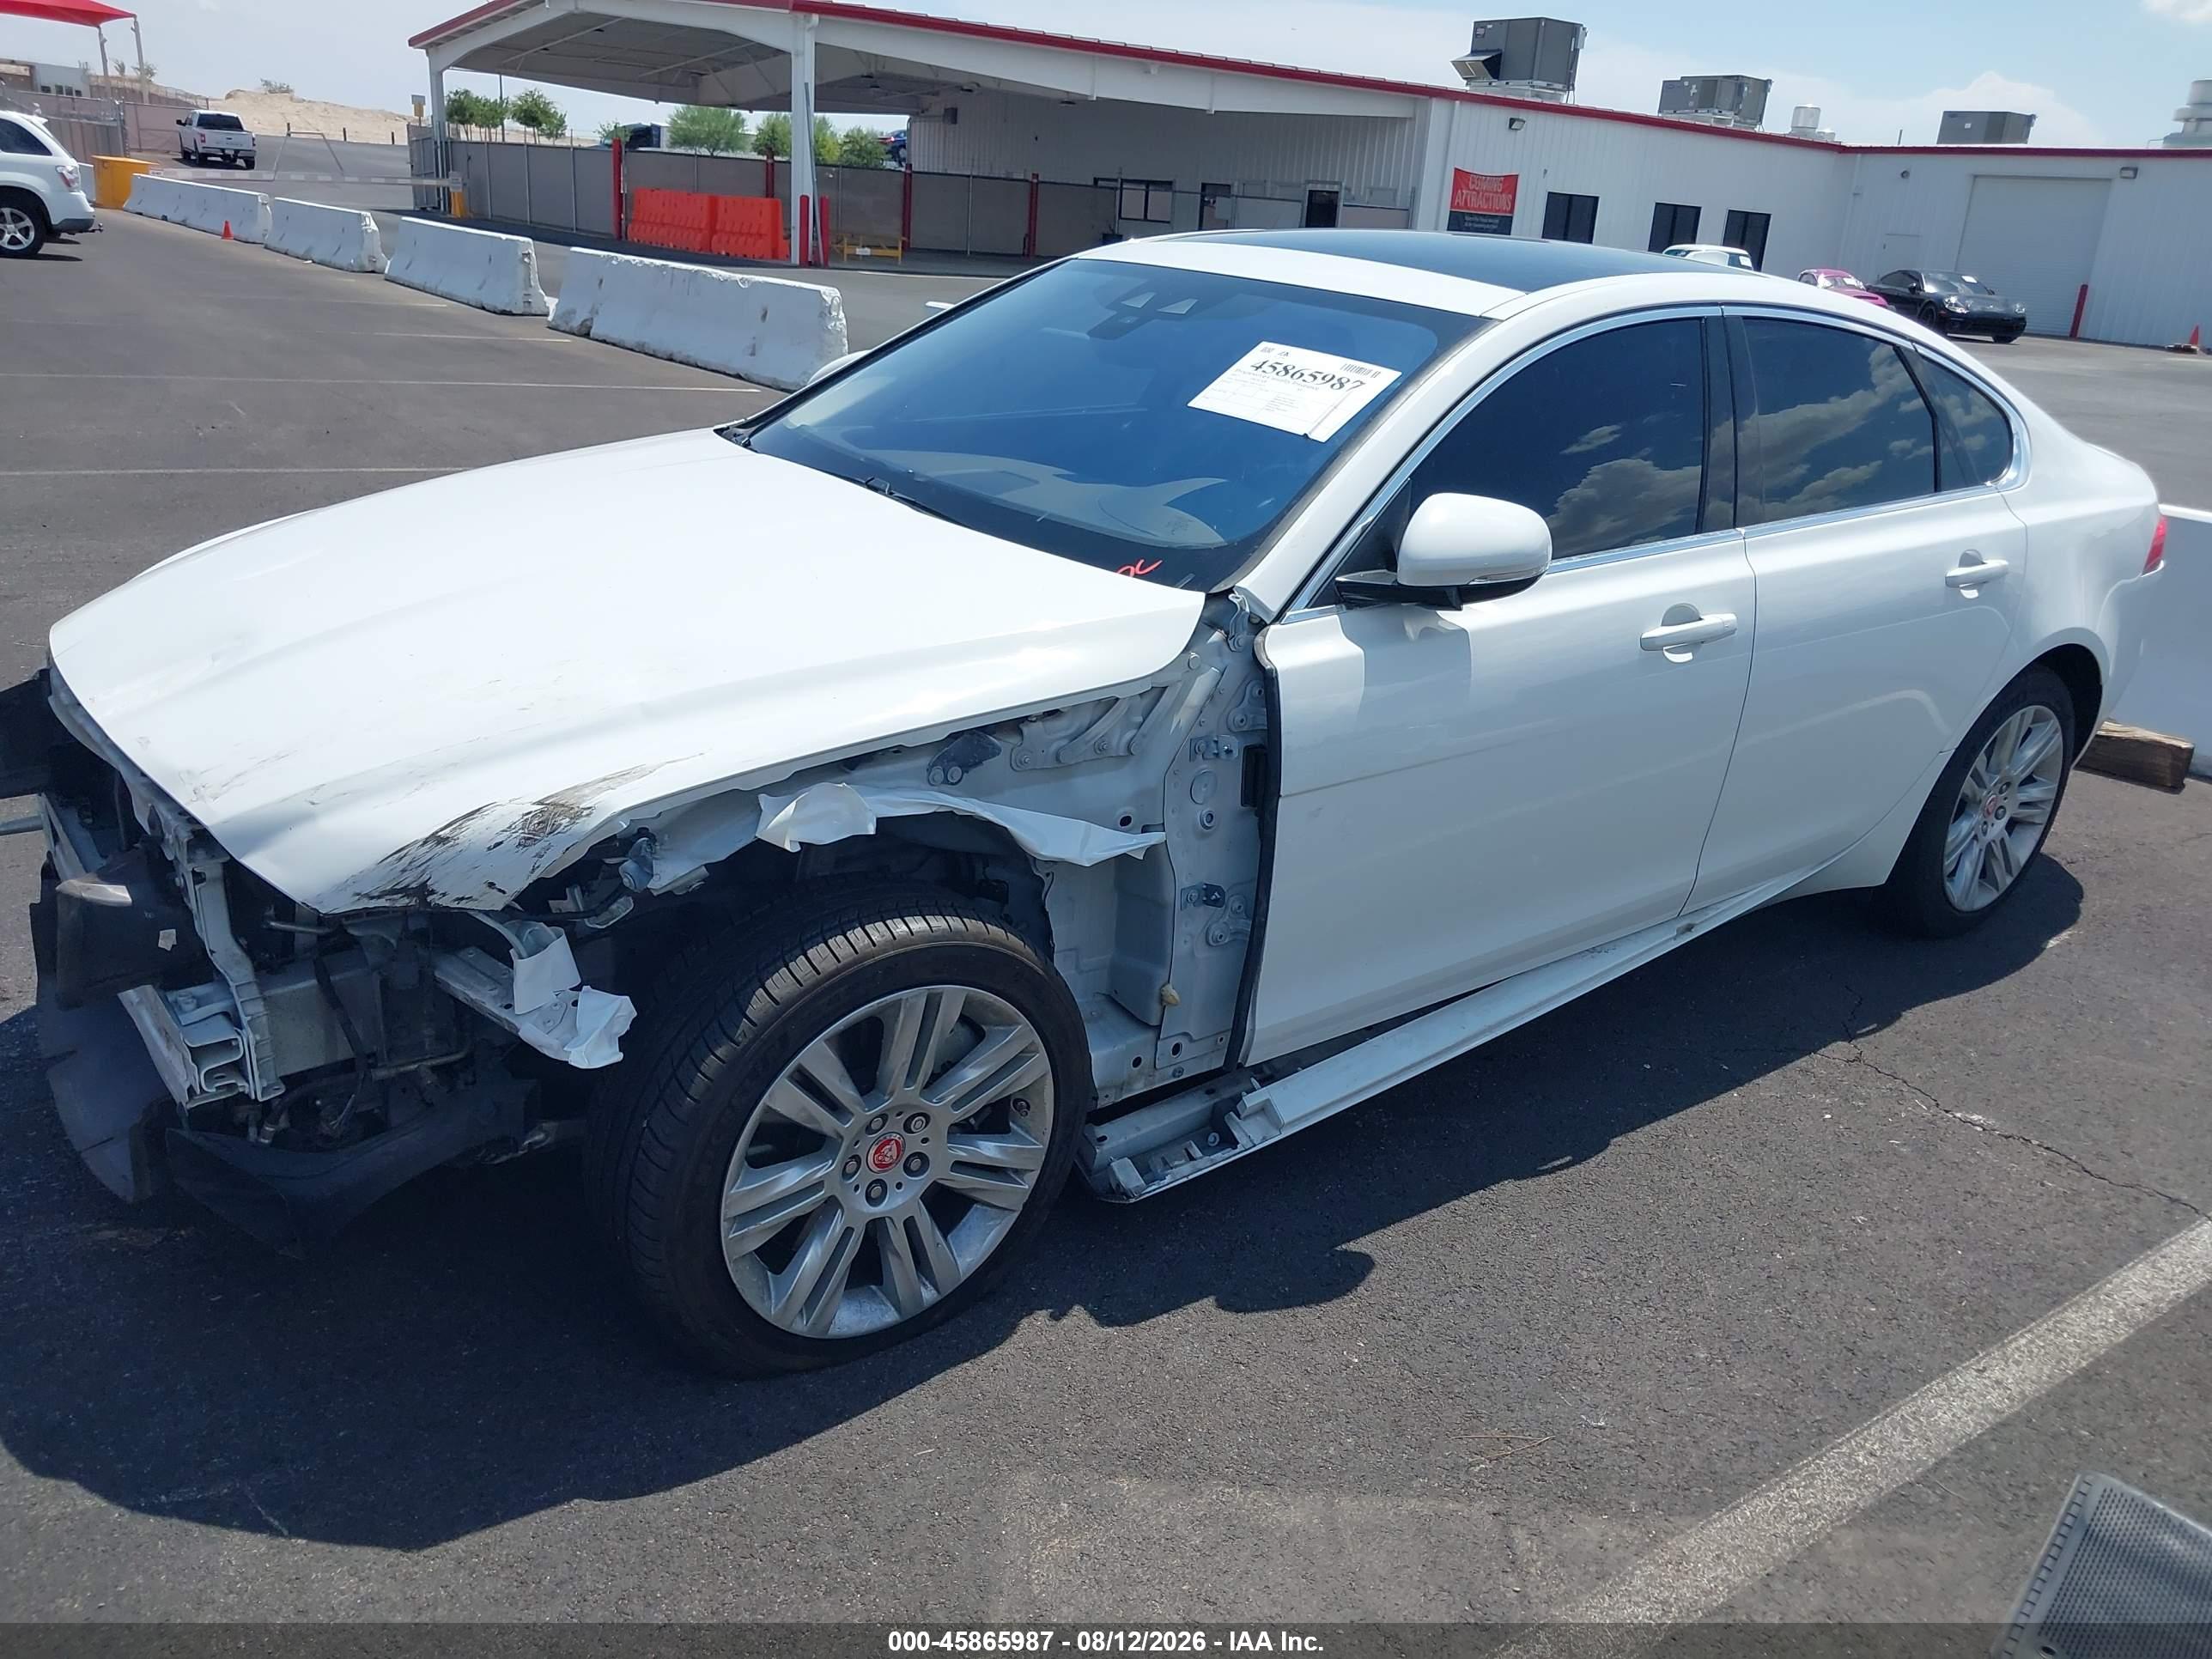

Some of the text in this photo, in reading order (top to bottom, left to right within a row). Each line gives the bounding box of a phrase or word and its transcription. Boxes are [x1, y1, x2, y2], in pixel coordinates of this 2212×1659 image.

[1469, 174, 1504, 192] COMING
[1455, 189, 1512, 211] ATTRACTIONS
[1250, 359, 1367, 391] 45865987
